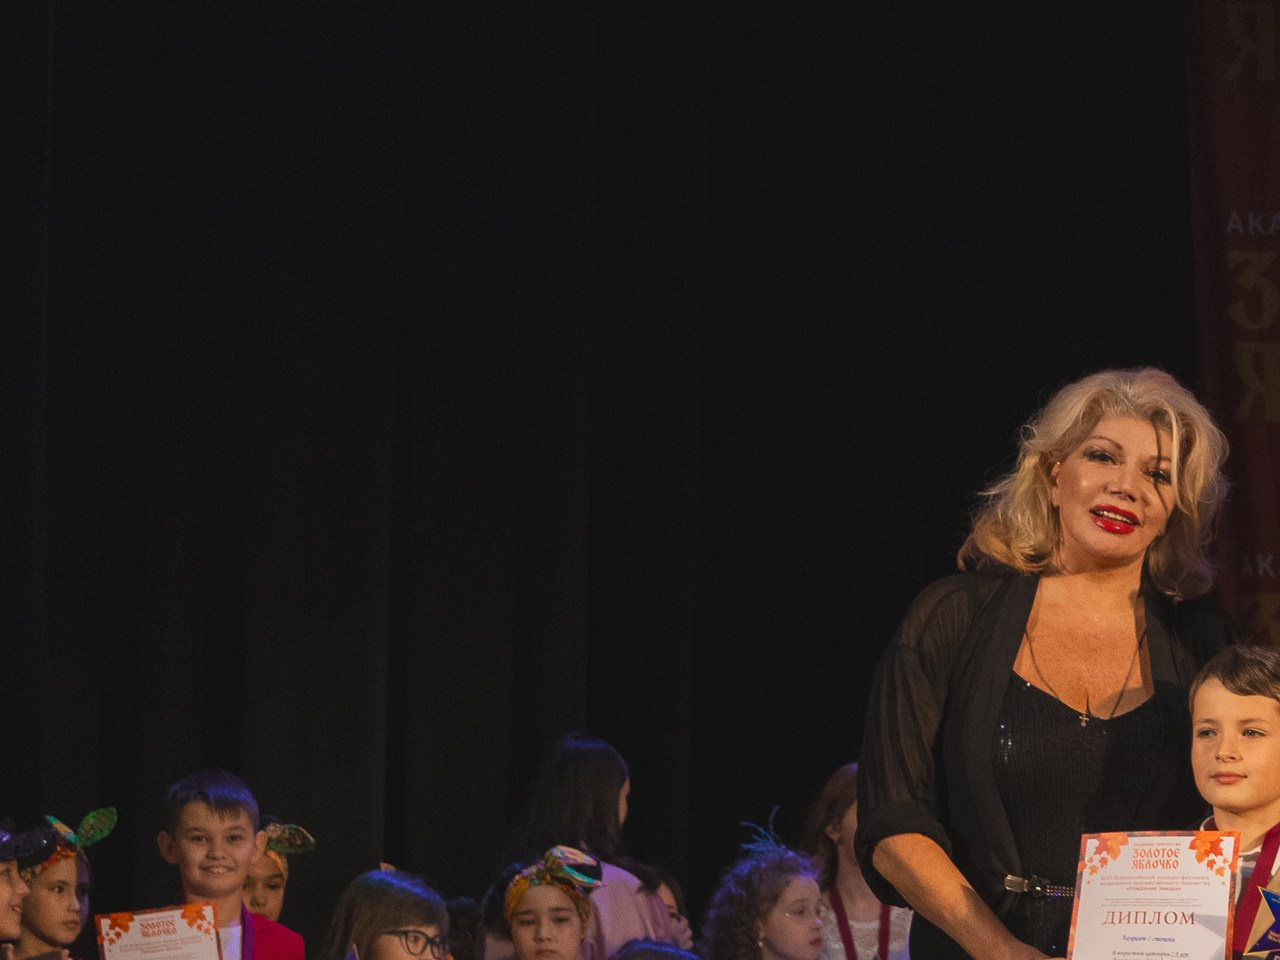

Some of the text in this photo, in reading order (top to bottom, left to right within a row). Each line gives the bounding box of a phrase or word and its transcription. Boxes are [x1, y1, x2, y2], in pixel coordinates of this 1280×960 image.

[1132, 847, 1181, 859] ЗОЛОТОЕ
[1131, 858, 1180, 870] ЯБЛОЧКО
[1102, 910, 1196, 926] ДИПЛОМ
